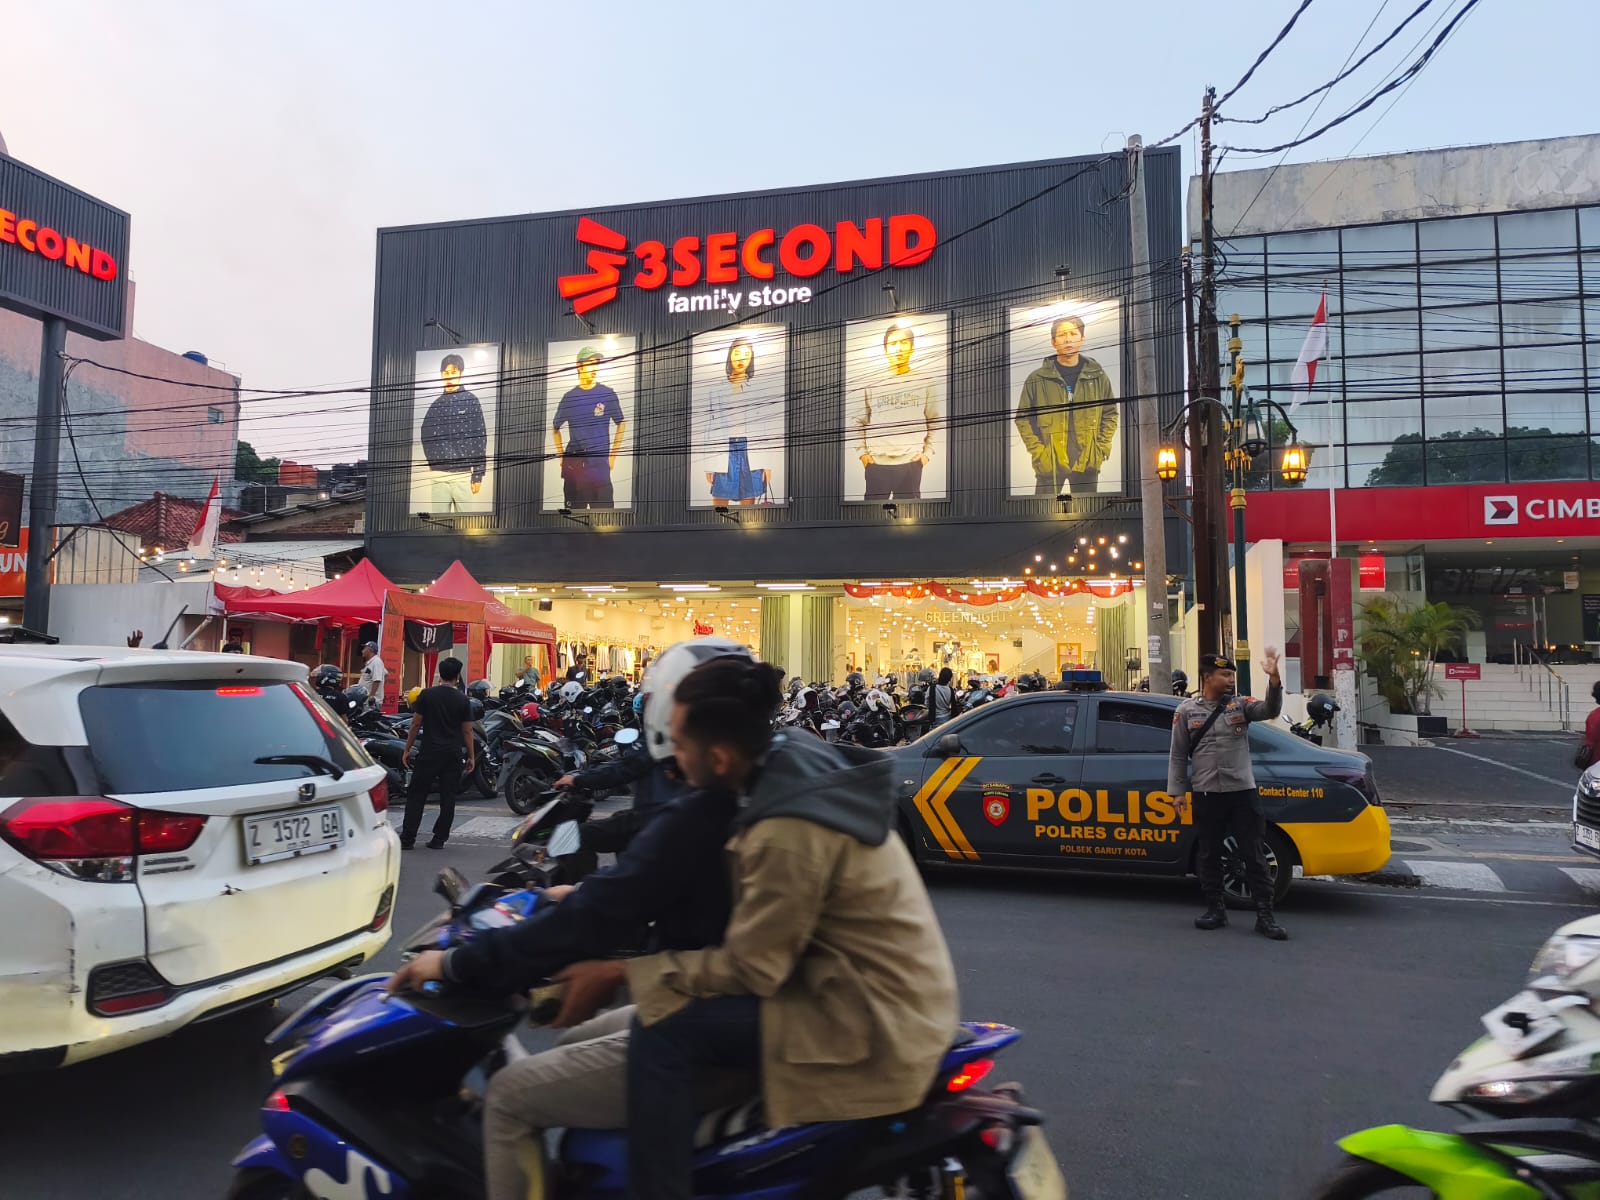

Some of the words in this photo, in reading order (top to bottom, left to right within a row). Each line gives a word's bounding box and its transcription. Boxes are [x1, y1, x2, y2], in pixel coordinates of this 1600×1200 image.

[634, 213, 937, 289] 3SECOND
[668, 288, 741, 314] family
[748, 285, 812, 307] store
[1525, 498, 1600, 520] CIMB
[1258, 786, 1285, 798] Contact
[1286, 787, 1310, 799] Center
[1311, 788, 1324, 799] 110
[1026, 788, 1193, 825] POLISI
[250, 824, 261, 847] Z
[273, 817, 311, 842] 1572
[321, 812, 338, 835] GA
[1035, 824, 1107, 840] POLRES
[1113, 828, 1180, 843] GARUT
[1060, 844, 1092, 854] POLSEK
[1094, 846, 1123, 856] GARUT
[1124, 848, 1147, 857] KOTA
